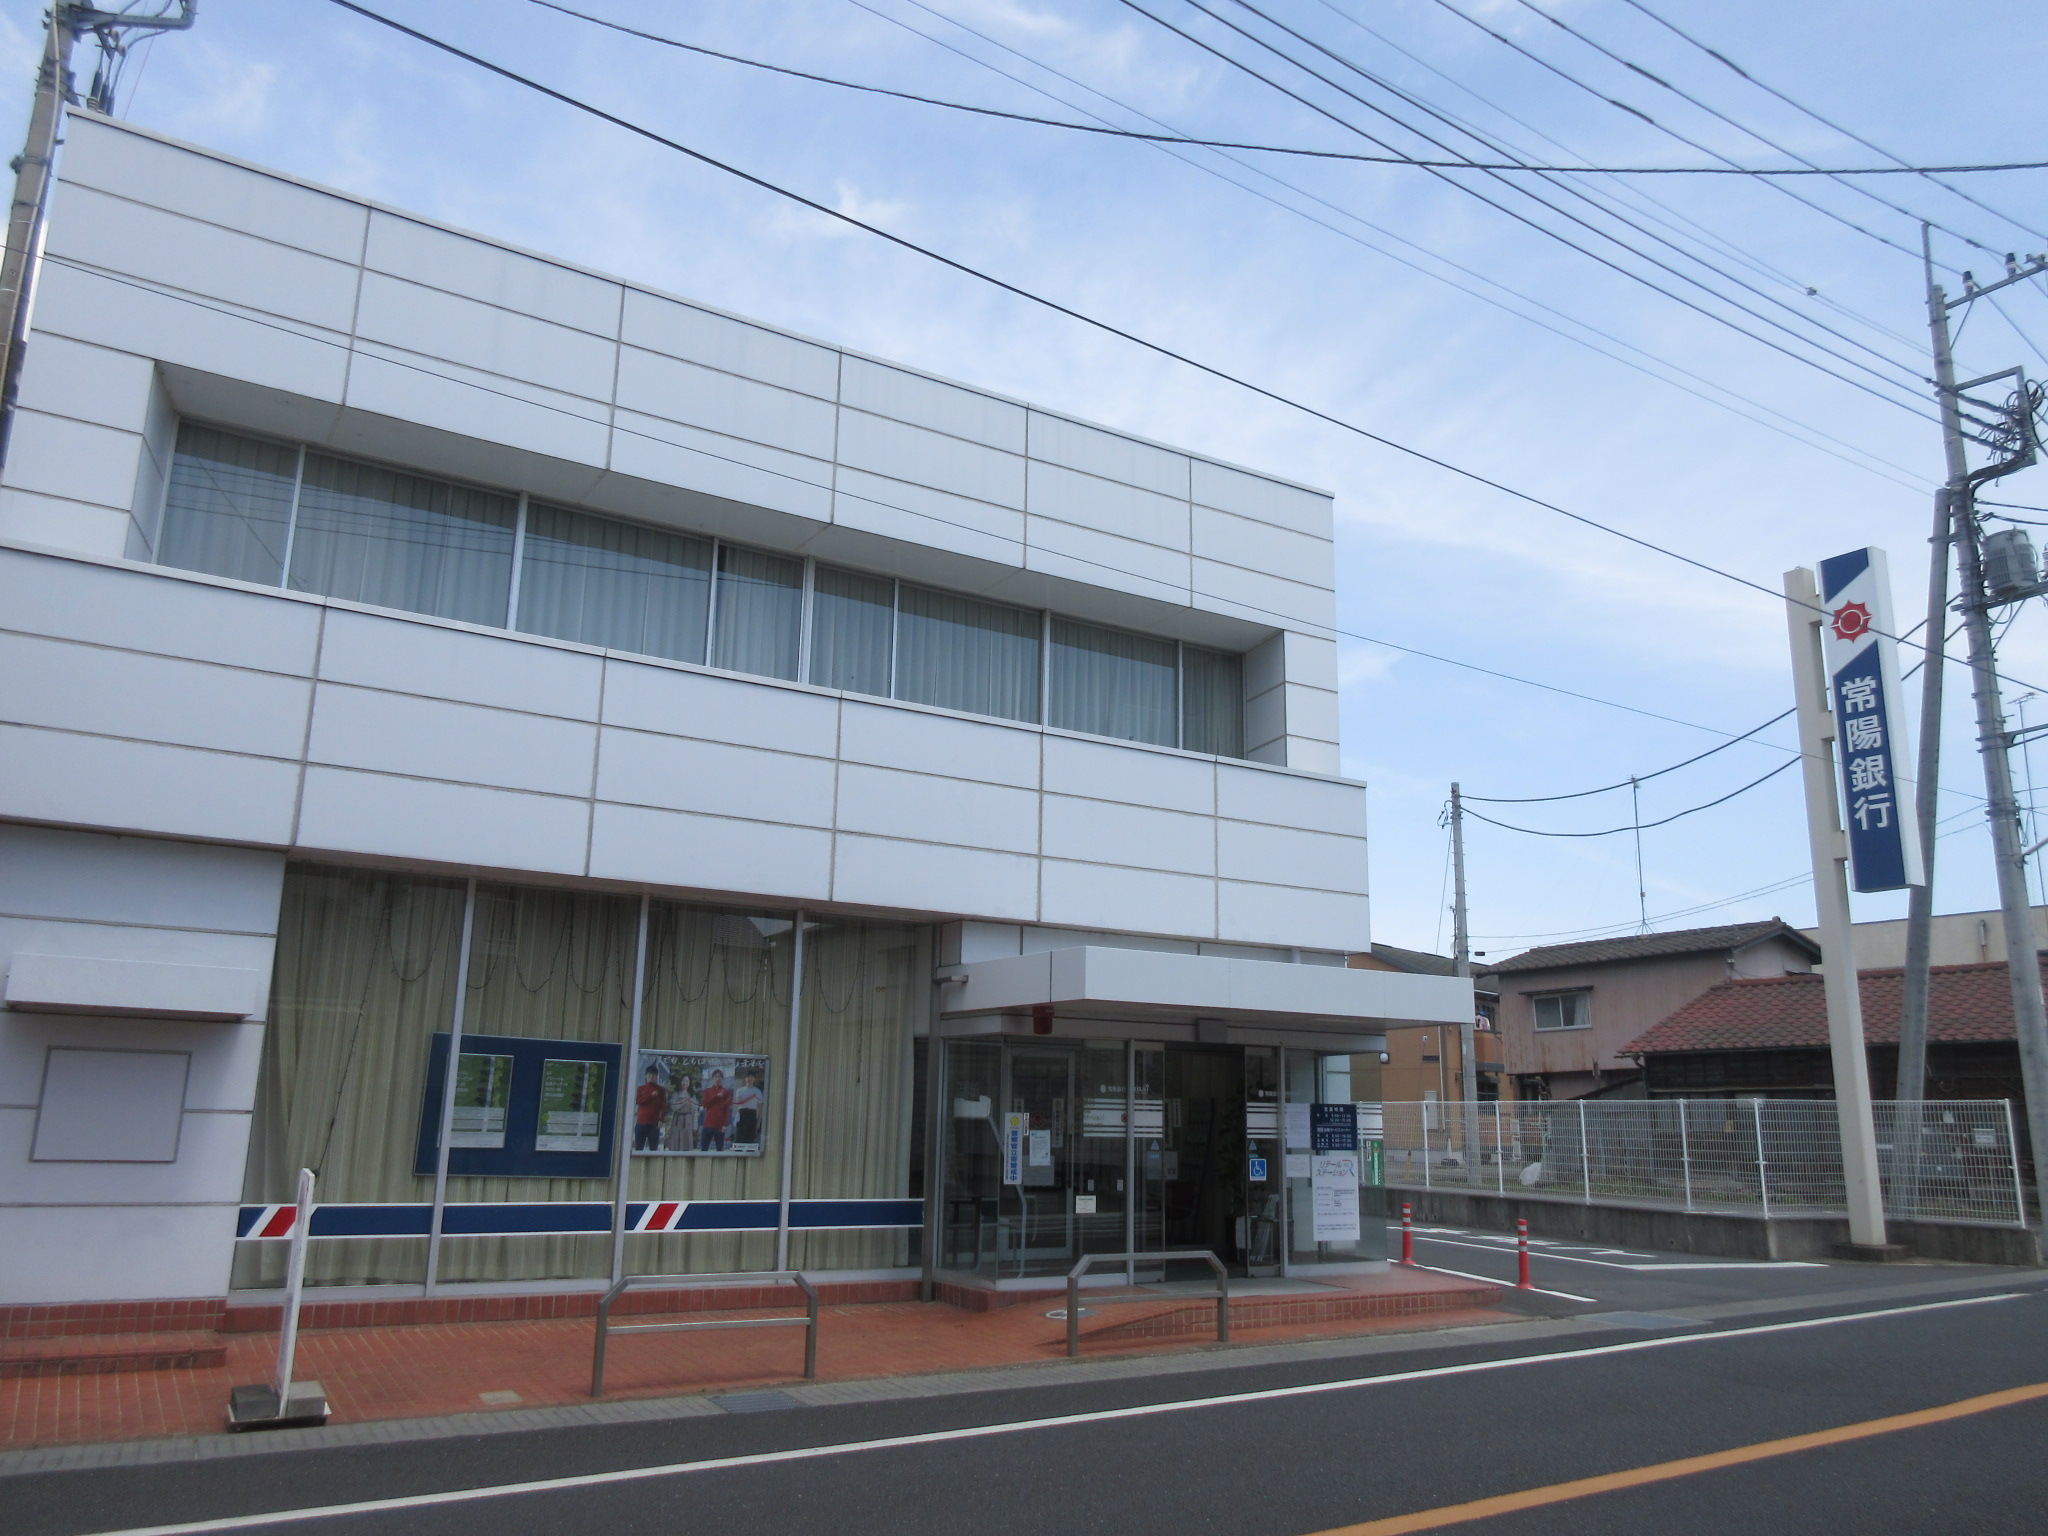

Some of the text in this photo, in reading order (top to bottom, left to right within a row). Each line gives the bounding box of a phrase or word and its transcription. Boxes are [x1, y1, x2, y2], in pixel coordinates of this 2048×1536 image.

[1840, 674, 1891, 831] 常陽銀行
[1320, 1160, 1342, 1168] リテール
[1315, 1169, 1348, 1177] ステーション
